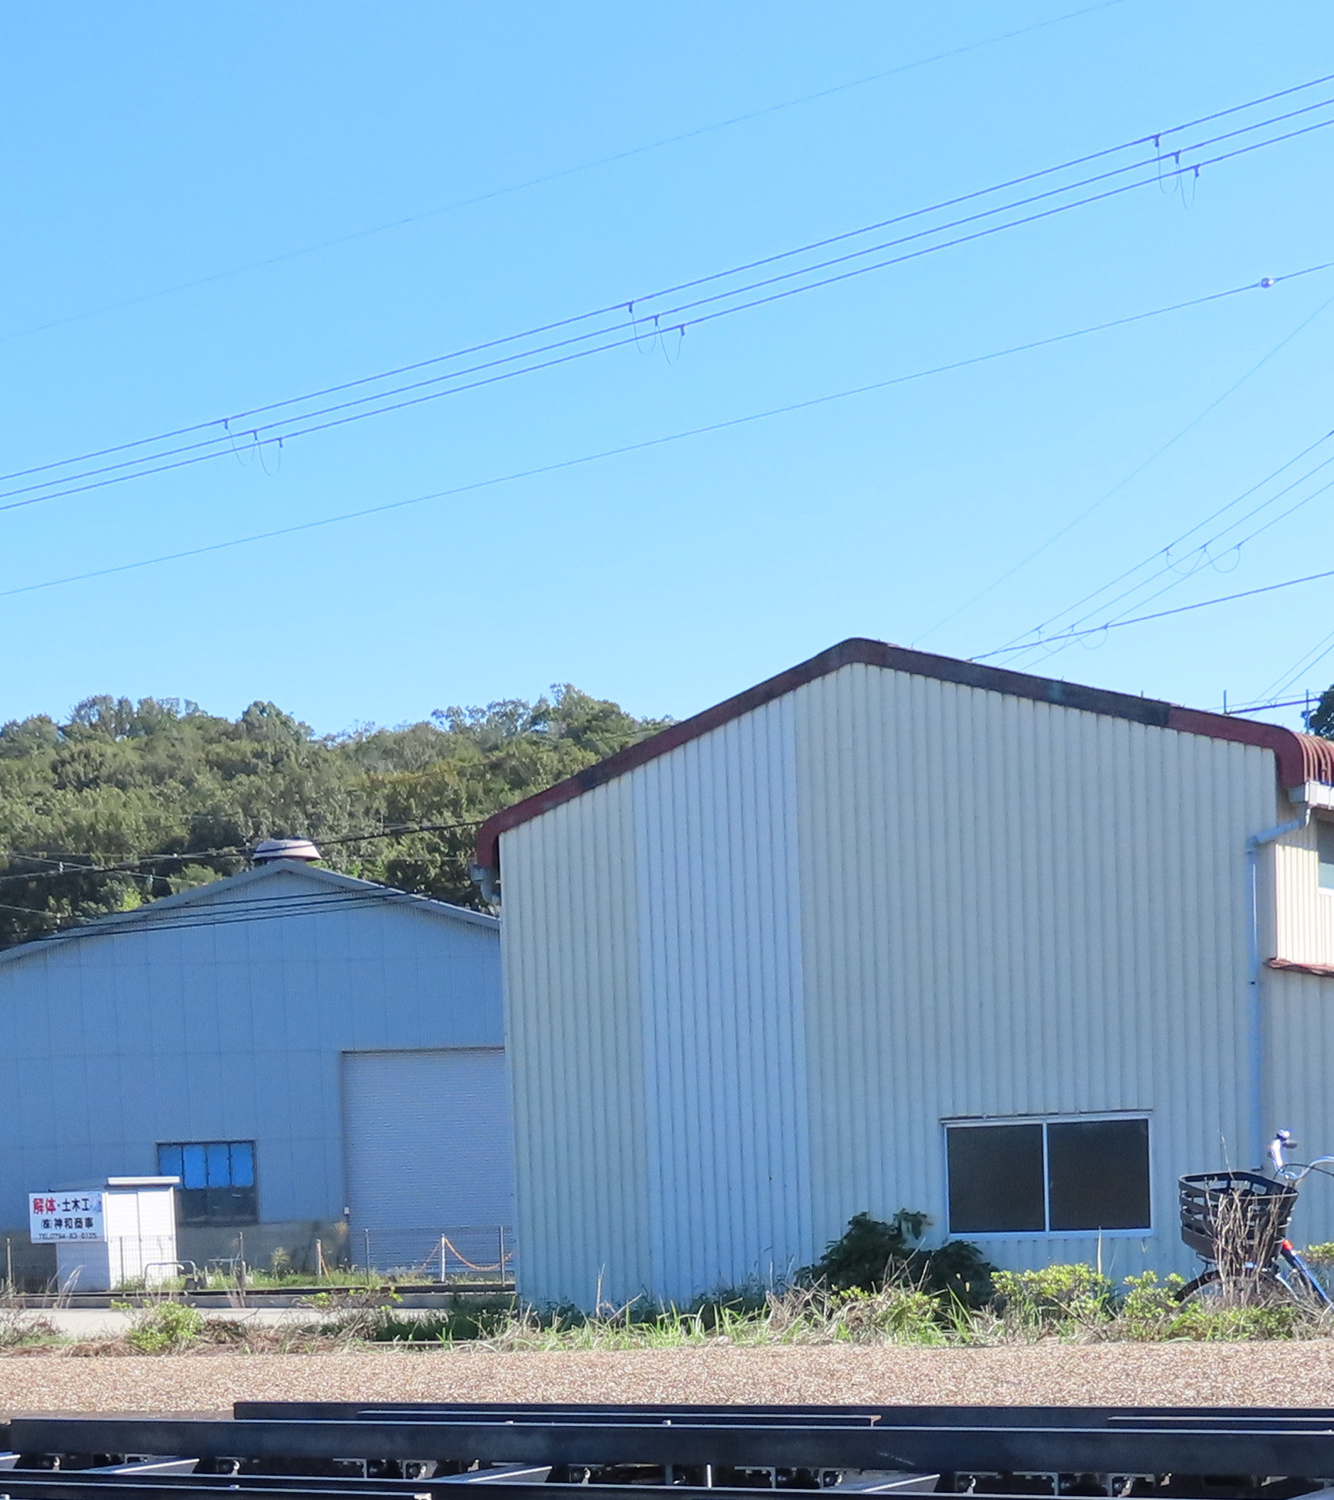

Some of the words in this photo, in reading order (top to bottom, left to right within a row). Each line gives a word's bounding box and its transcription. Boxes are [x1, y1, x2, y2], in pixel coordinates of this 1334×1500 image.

[33, 1197, 101, 1214] 解体・土木工
